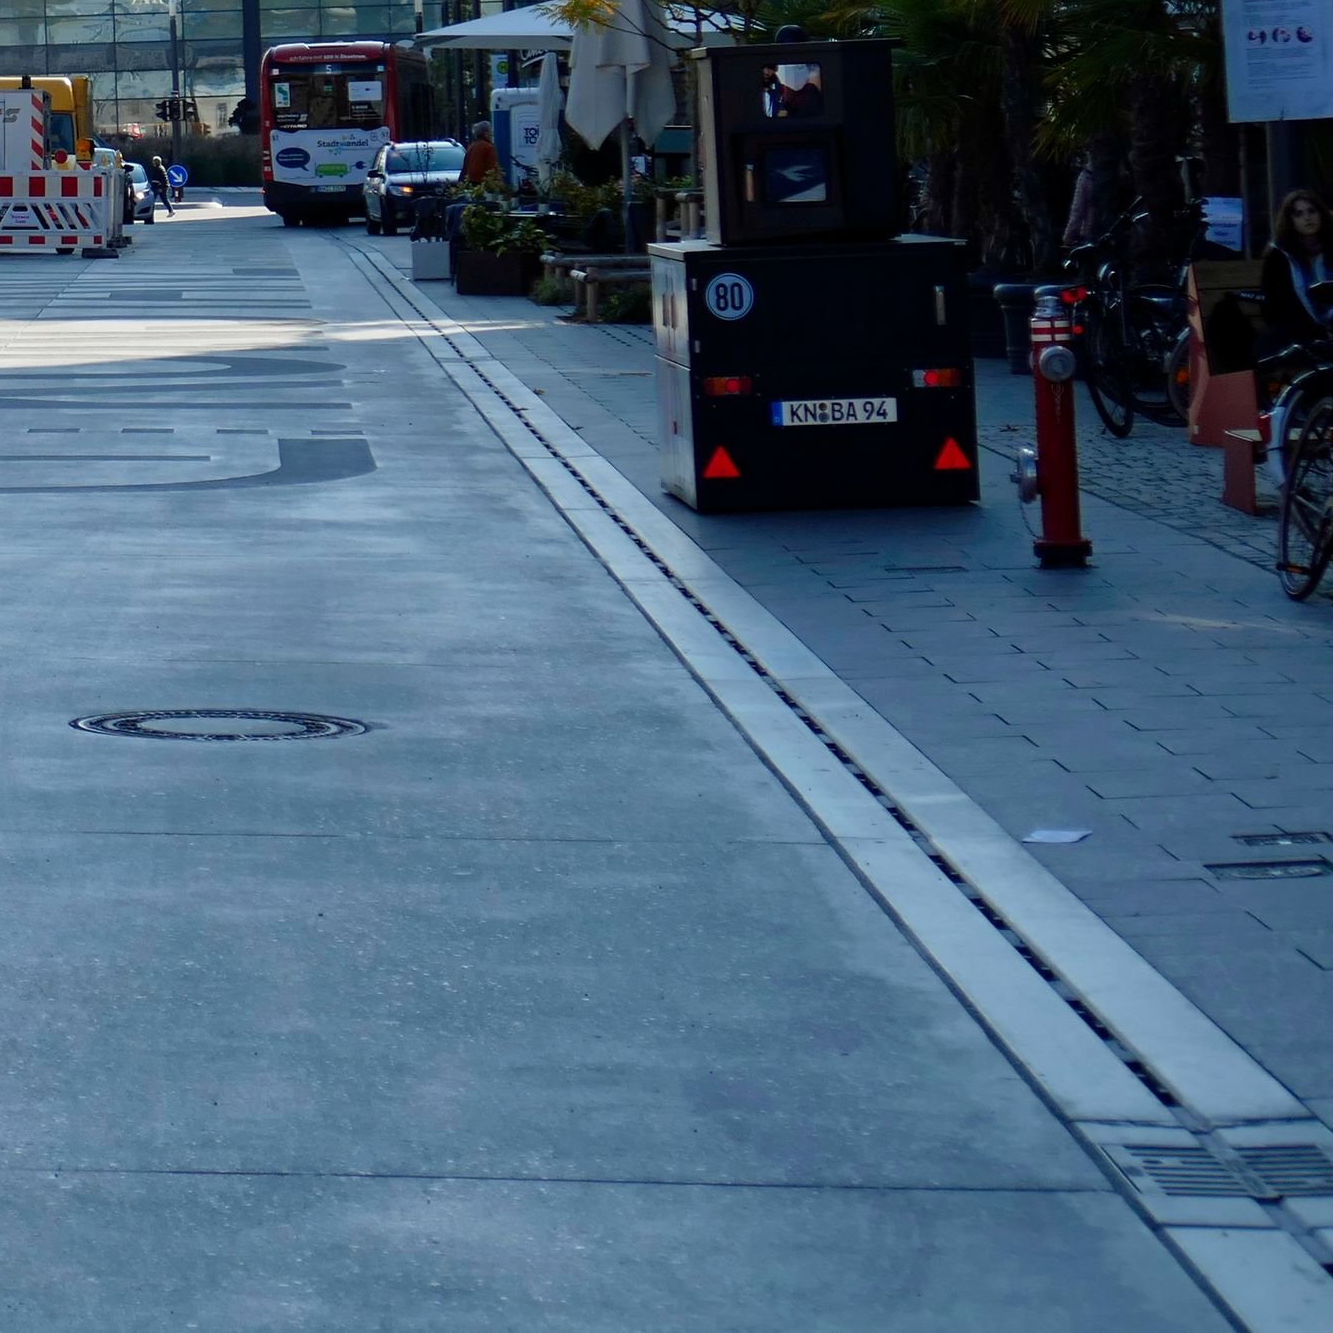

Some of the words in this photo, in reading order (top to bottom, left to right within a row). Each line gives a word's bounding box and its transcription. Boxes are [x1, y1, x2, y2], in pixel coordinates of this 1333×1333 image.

[716, 282, 743, 311] 80
[790, 403, 818, 423] KN
[831, 401, 858, 422] BA
[863, 400, 888, 420] 94
